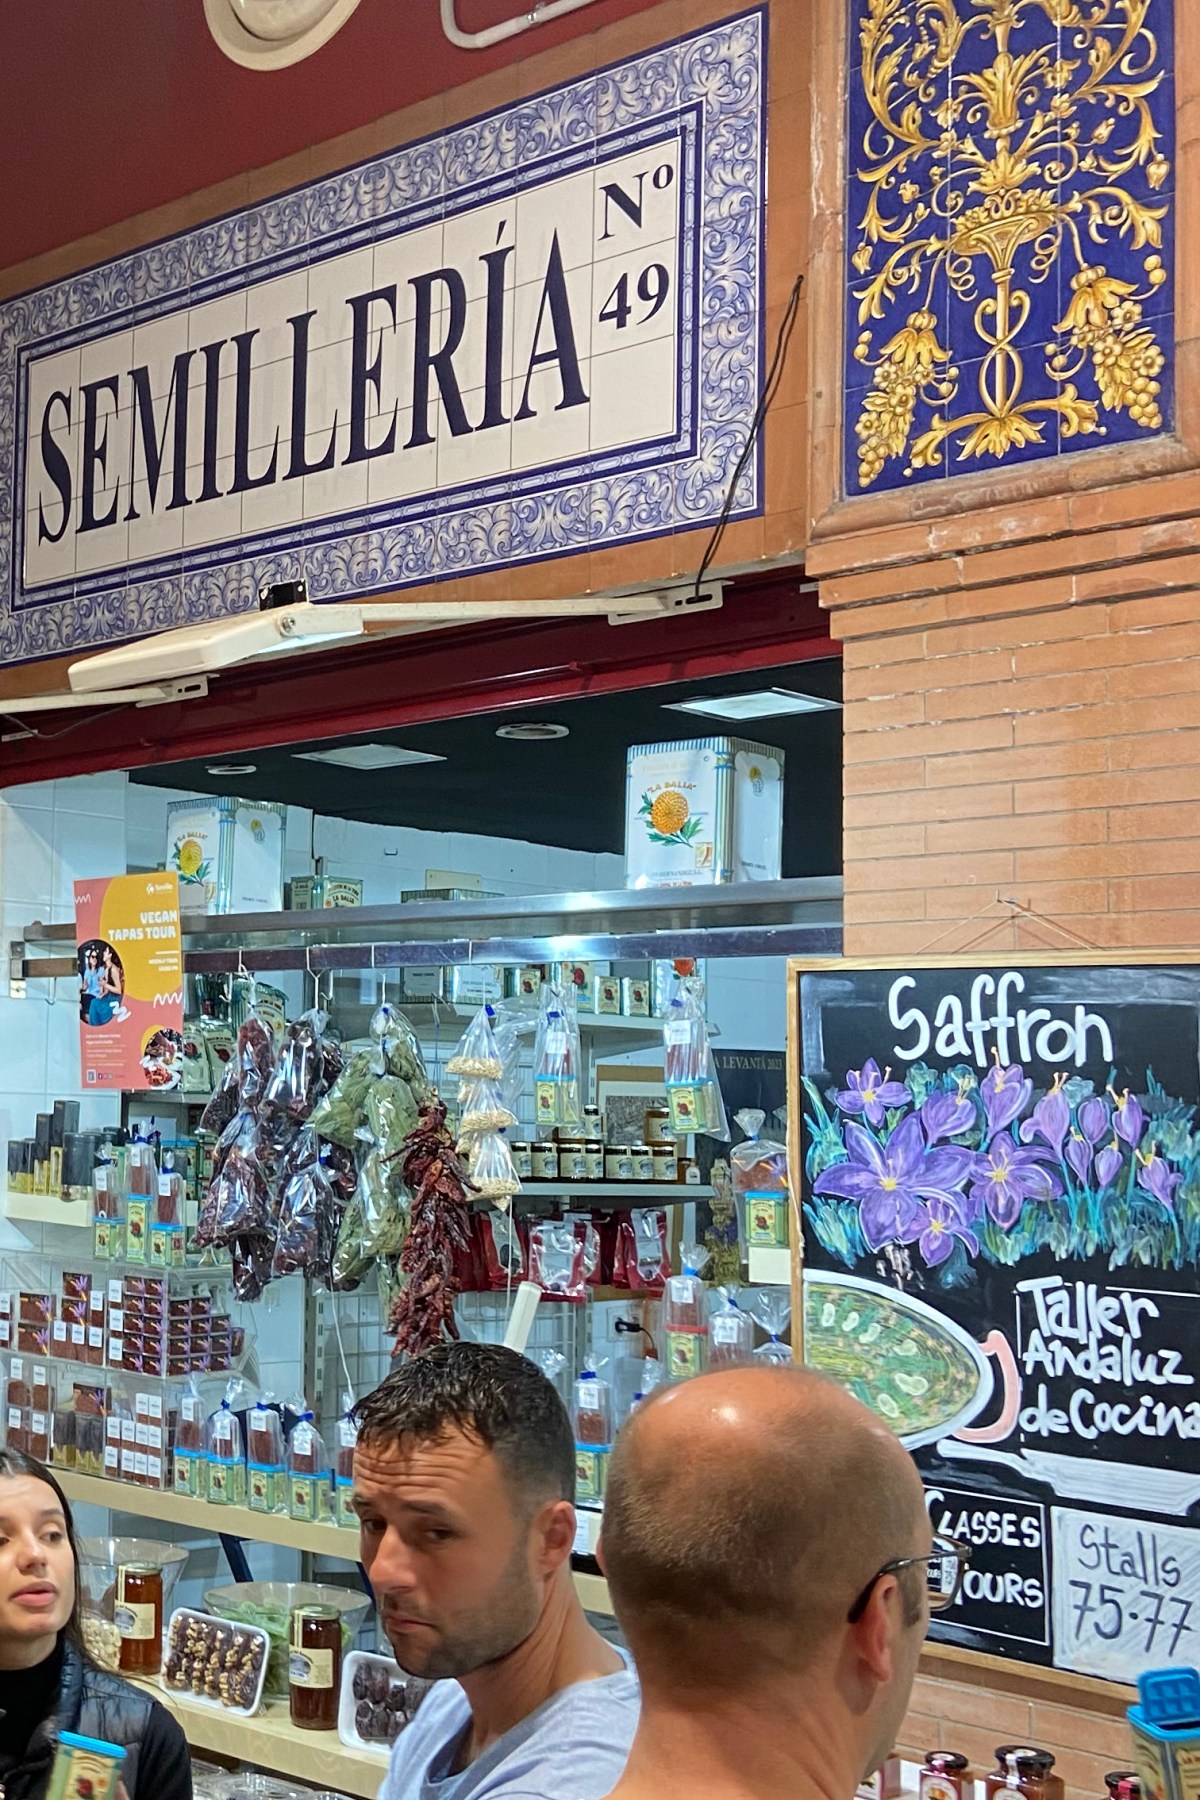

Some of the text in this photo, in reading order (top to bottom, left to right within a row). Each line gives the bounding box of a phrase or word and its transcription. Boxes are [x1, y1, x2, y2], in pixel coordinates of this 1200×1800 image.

[598, 163, 674, 240] Nº
[598, 263, 671, 331] 49
[38, 221, 590, 547] SEMILLERÍA
[108, 926, 177, 941] TAPAS TOUR
[140, 910, 178, 925] VEGAN
[888, 971, 1113, 1065] Saffron
[723, 1054, 766, 1070] LEVANTÁ
[1017, 1275, 1160, 1341] Taller
[1022, 1331, 1194, 1384] Andaluz
[1020, 1385, 1200, 1440] de Cocina
[924, 1490, 1041, 1548] CLASSES
[1077, 1523, 1182, 1588] Stalls
[955, 1562, 1044, 1609] OURS
